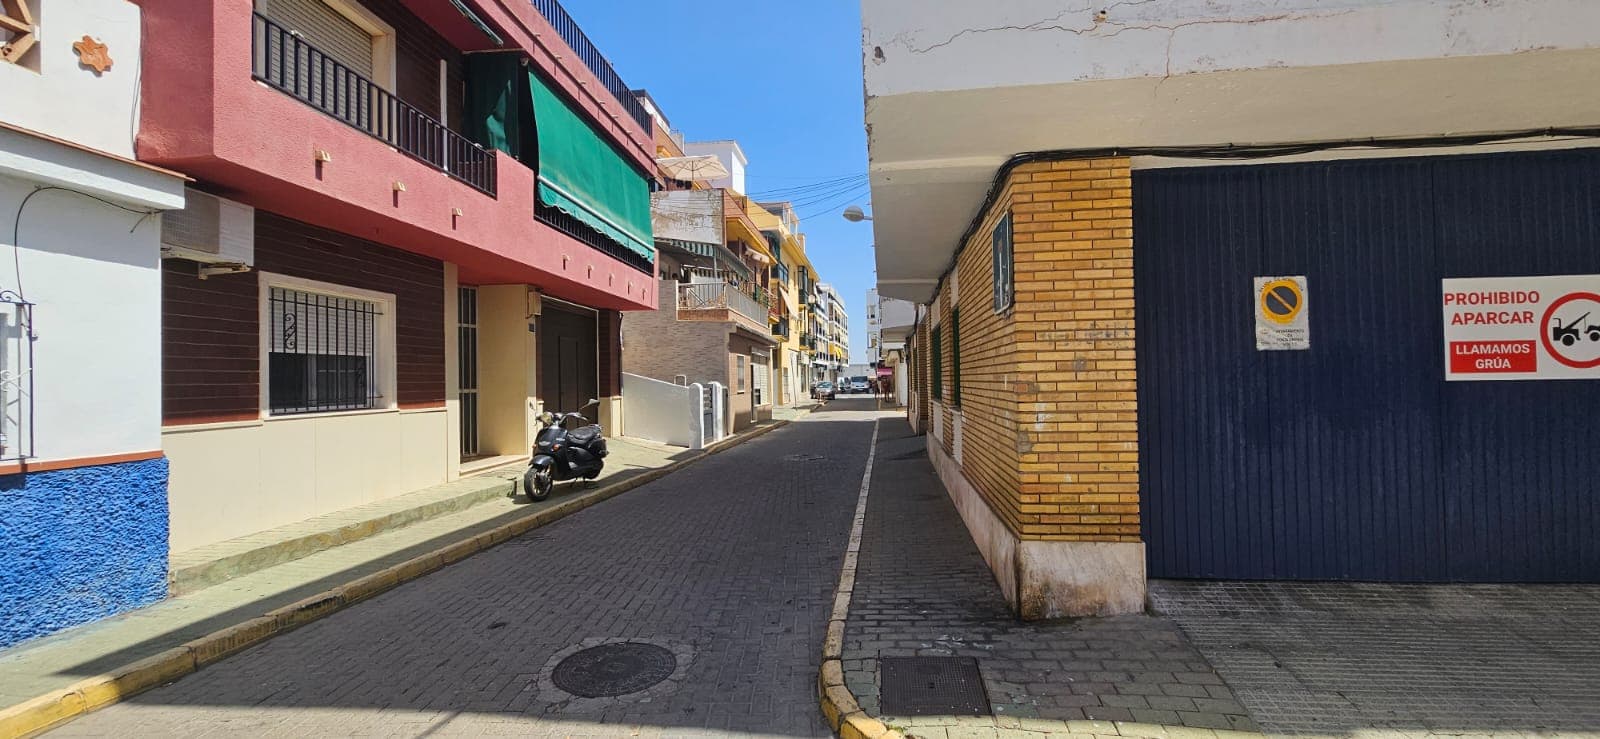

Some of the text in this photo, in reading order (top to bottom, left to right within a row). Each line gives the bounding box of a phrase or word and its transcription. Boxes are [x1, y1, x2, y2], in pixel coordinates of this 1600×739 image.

[1444, 290, 1540, 306] PROHIBIDO
[1451, 311, 1534, 325] APARCAR
[1455, 343, 1530, 355] LLAMAMOS
[1475, 356, 1512, 369] GRÚA
